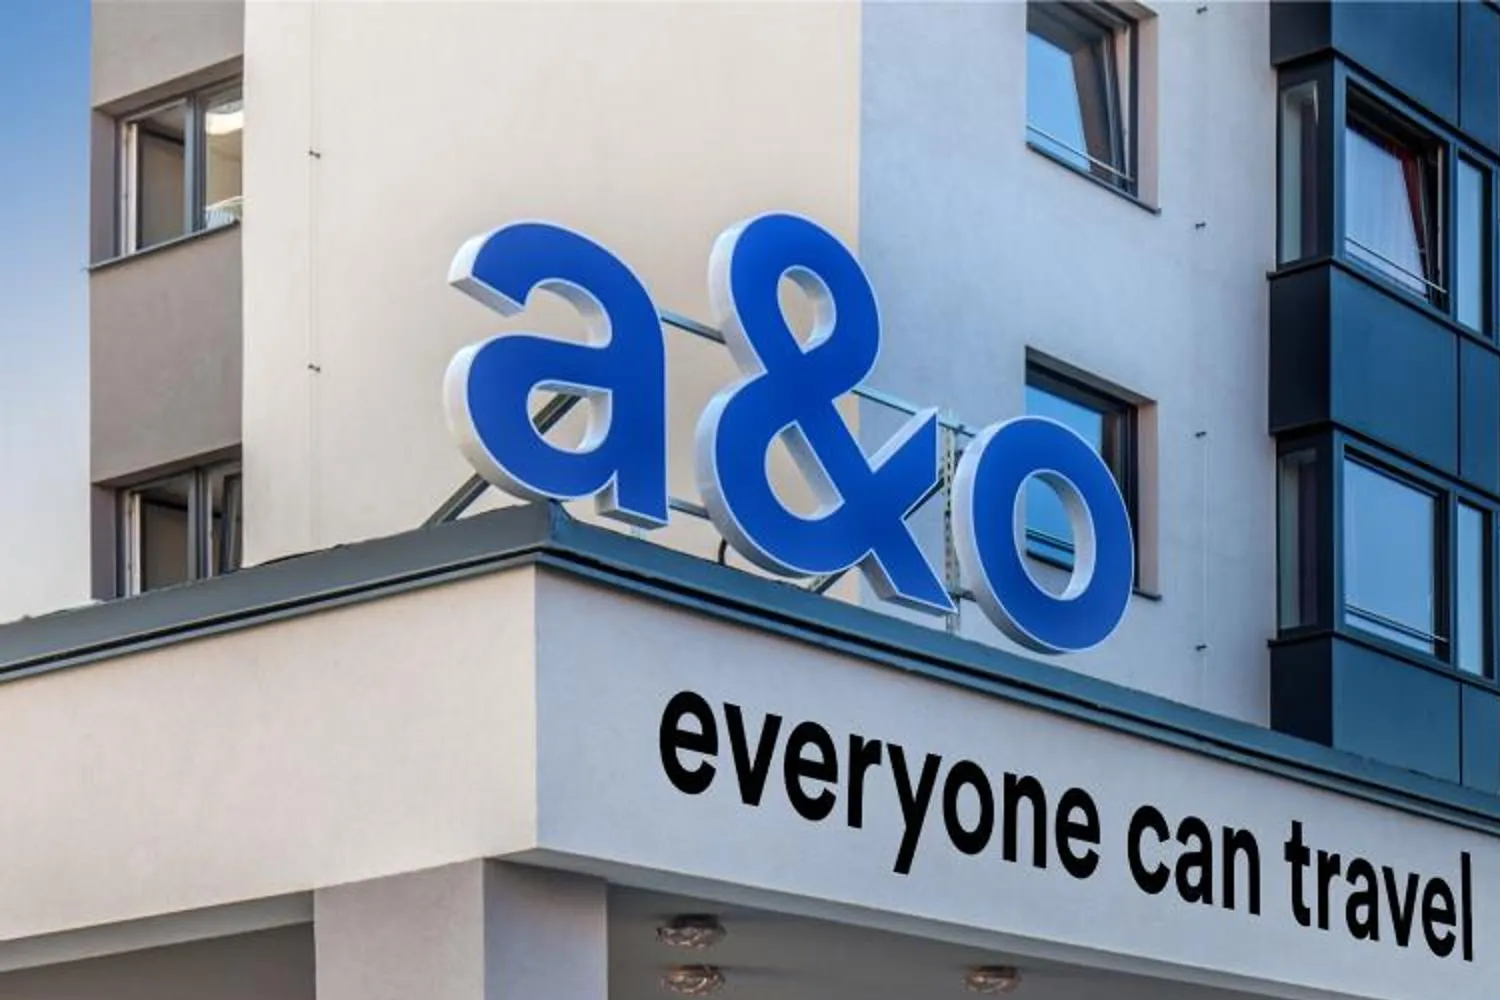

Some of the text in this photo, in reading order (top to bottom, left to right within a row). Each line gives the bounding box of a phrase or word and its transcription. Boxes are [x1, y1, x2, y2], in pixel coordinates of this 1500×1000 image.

[446, 211, 1134, 653] a&o
[659, 690, 1473, 962] everyone can travel
